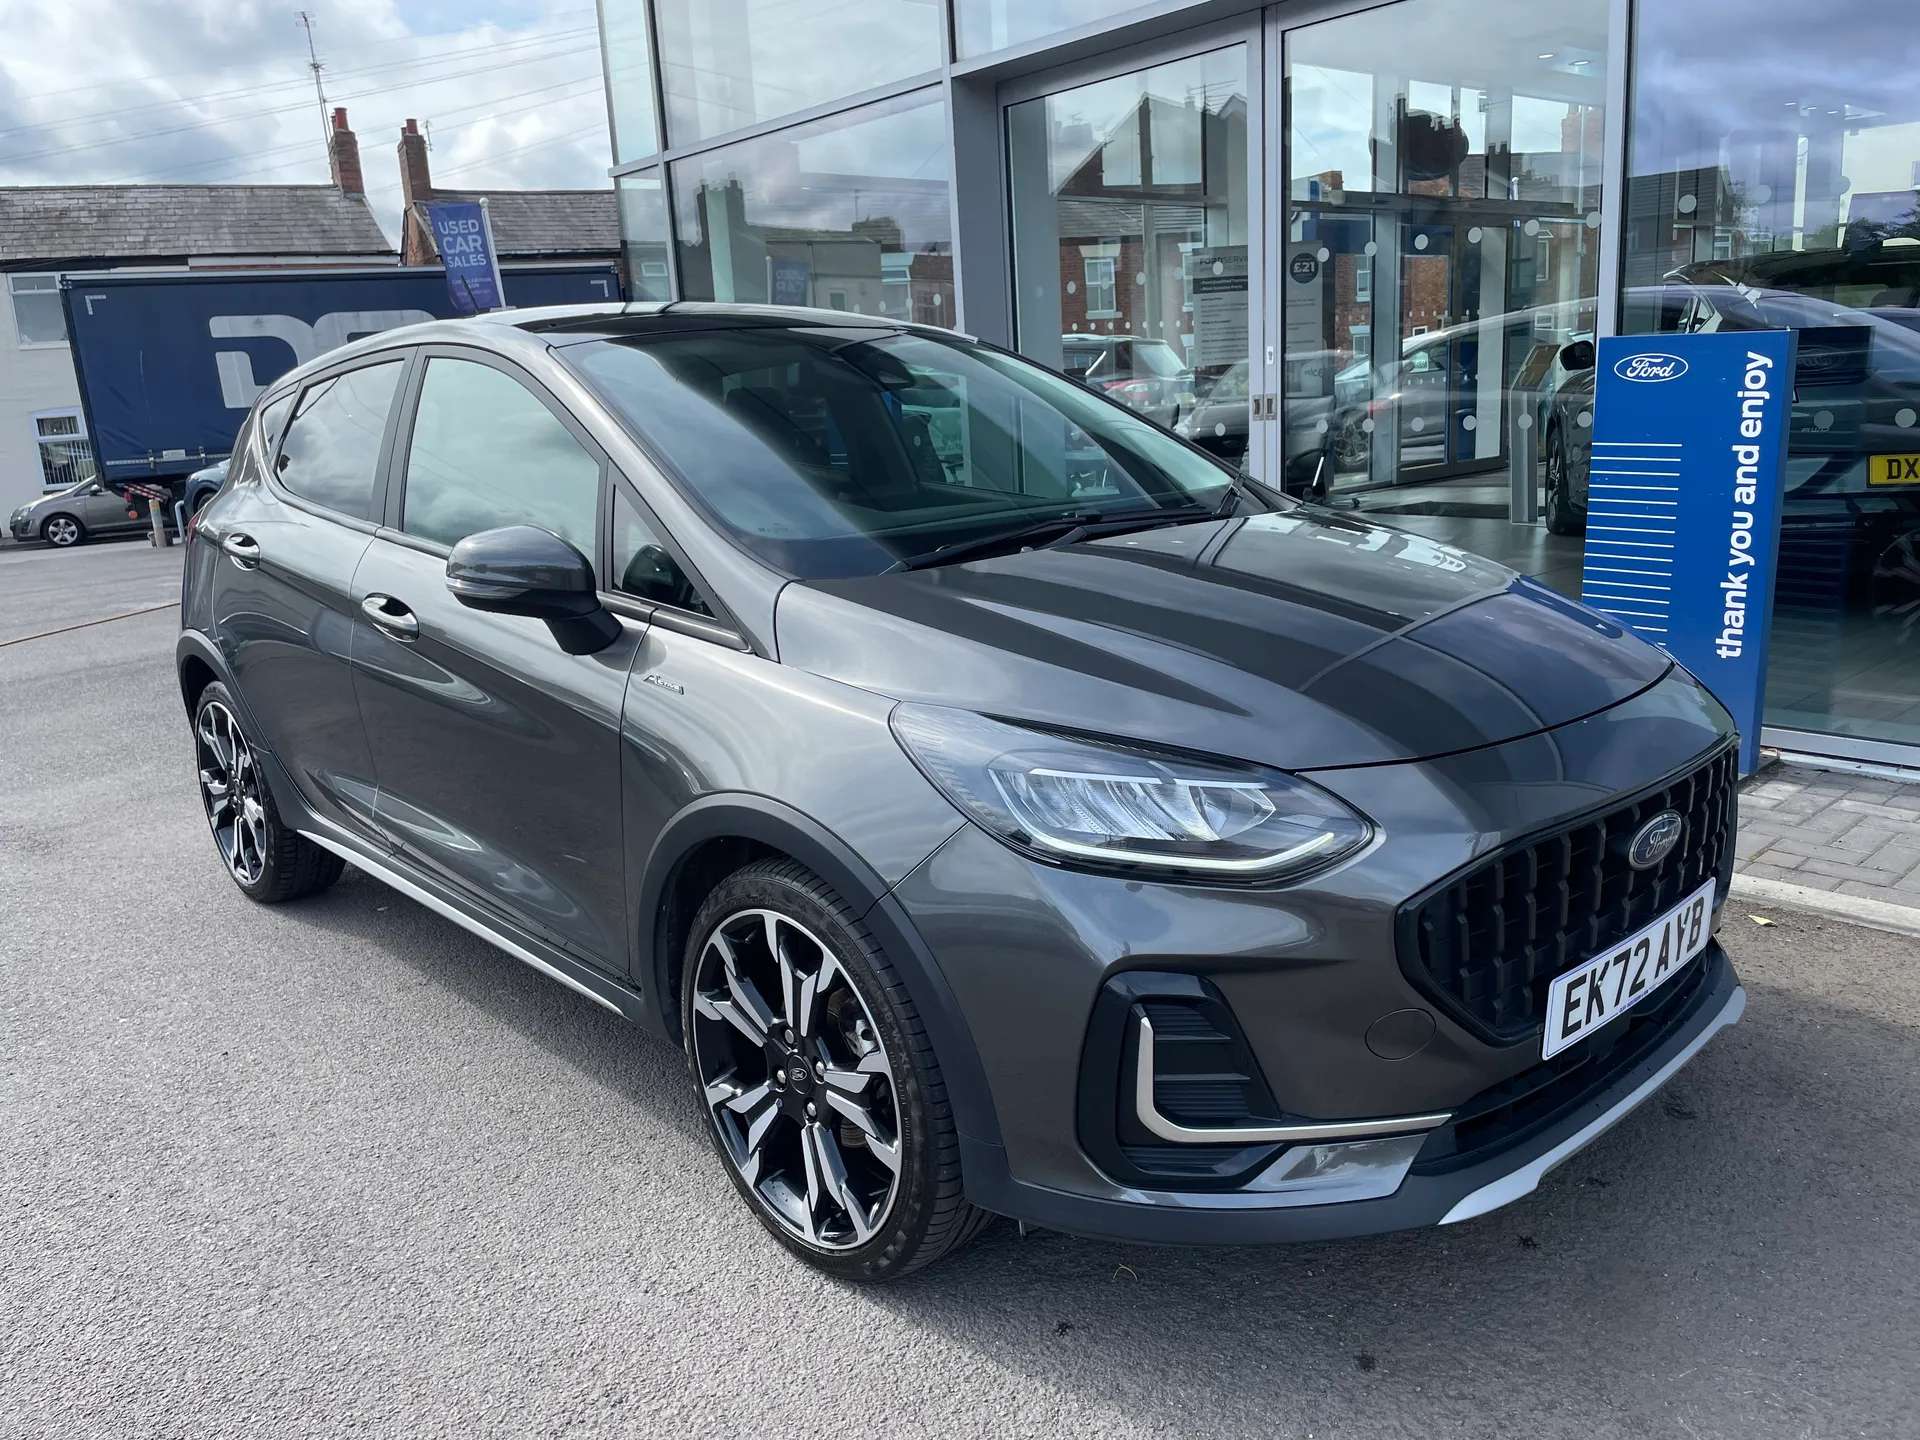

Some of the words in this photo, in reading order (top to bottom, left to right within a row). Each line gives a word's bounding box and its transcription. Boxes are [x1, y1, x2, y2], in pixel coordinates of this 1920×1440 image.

[438, 219, 480, 235] USED
[443, 235, 483, 254] CAR
[447, 254, 487, 268] SALES
[1293, 261, 1315, 273] £21
[1626, 356, 1674, 378] Ford
[1737, 351, 1773, 439] enjoy
[1732, 445, 1760, 505] and
[1728, 511, 1755, 567] you
[1716, 572, 1749, 659] thank
[1561, 937, 1650, 1040] EK72
[1654, 896, 1704, 979] AYB
